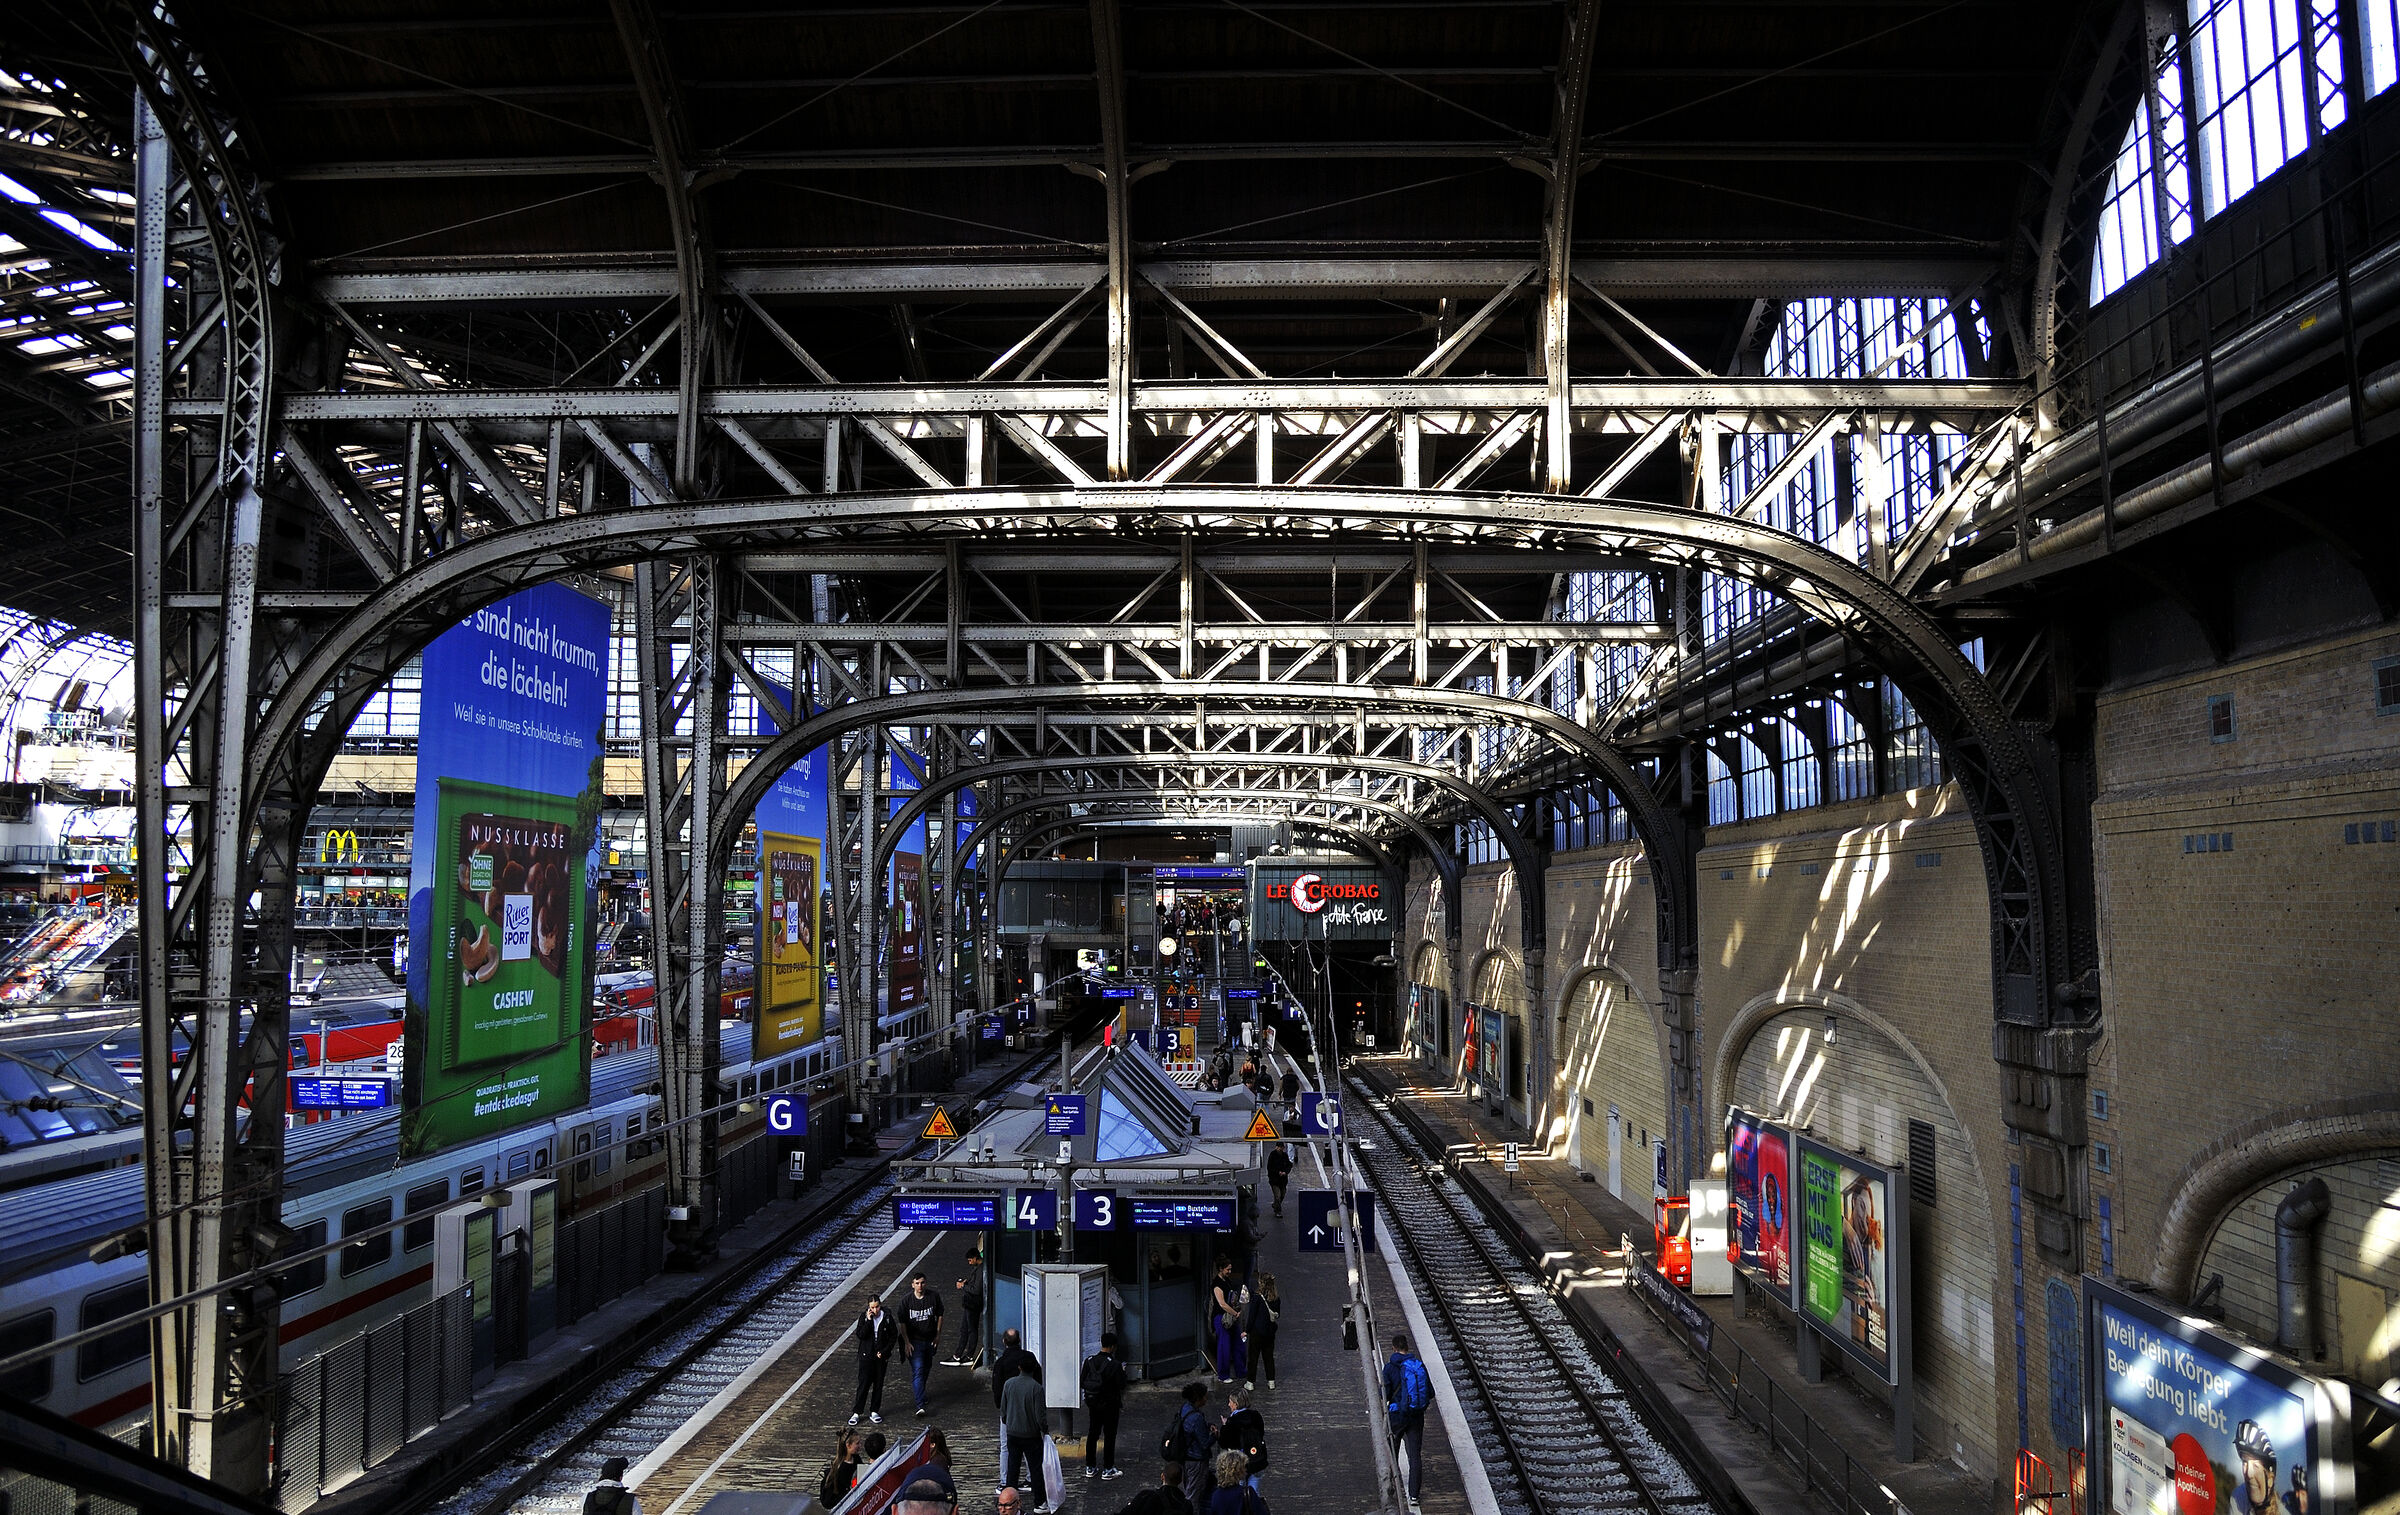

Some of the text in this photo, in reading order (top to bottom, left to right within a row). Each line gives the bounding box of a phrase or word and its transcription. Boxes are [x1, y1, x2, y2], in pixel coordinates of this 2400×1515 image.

[476, 605, 511, 641] sind
[514, 617, 549, 654] nicht
[552, 624, 599, 678] krumm,
[481, 649, 568, 709] die lächeln!
[454, 702, 584, 749] Weil sie in unsere Schokolade dürfen.
[471, 825, 565, 849] NUSSKLASSE
[473, 860, 492, 871] OHNE
[1266, 884, 1379, 899] LE CROBAG
[506, 903, 530, 930] Ritter
[1351, 902, 1387, 927] France
[504, 931, 530, 946] SPORT
[493, 989, 535, 1010] CASHEW
[1165, 998, 1173, 1008] 4
[1191, 998, 1198, 1008] 3
[1167, 1033, 1178, 1050] 3
[769, 1099, 792, 1130] G
[792, 1153, 803, 1171] H
[1506, 1144, 1517, 1160] H
[1808, 1160, 1837, 1195] ERST
[911, 1202, 940, 1210] Bergedorf
[1019, 1195, 1039, 1226] 4
[1093, 1196, 1112, 1226] 3
[1187, 1205, 1218, 1213] Buxtehude
[1808, 1188, 1828, 1218] MIT
[1808, 1215, 1834, 1249] UNS
[2105, 1315, 2232, 1399] Weil dein Körper
[2108, 1348, 2228, 1435] Bewegung liebt
[2113, 1441, 2143, 1467] KOLLAGEN
[2129, 1435, 2146, 1449] system
[2177, 1461, 2206, 1481] In deiner
[2177, 1478, 2210, 1500] Apotheke
